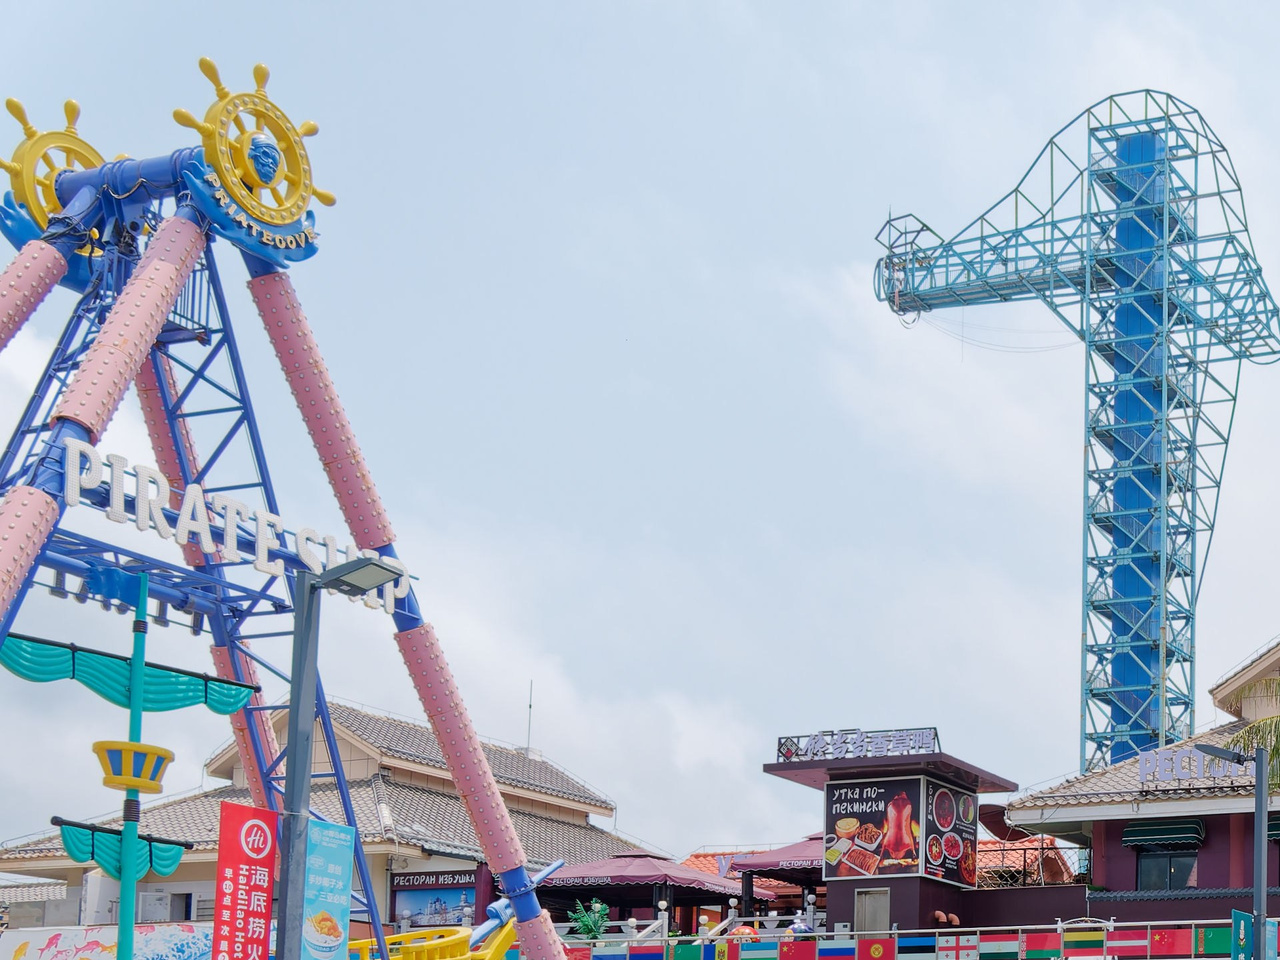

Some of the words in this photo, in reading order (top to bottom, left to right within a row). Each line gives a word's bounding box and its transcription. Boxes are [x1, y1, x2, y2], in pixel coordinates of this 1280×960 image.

[63, 437, 284, 577] PIRATE
[295, 528, 410, 614] SP
[247, 827, 266, 848] Hi
[394, 875, 435, 886] РЕСТОРАН
[439, 874, 475, 884] ИЗБУШКА
[235, 864, 249, 928] Haidilao
[233, 932, 244, 958] Hot
